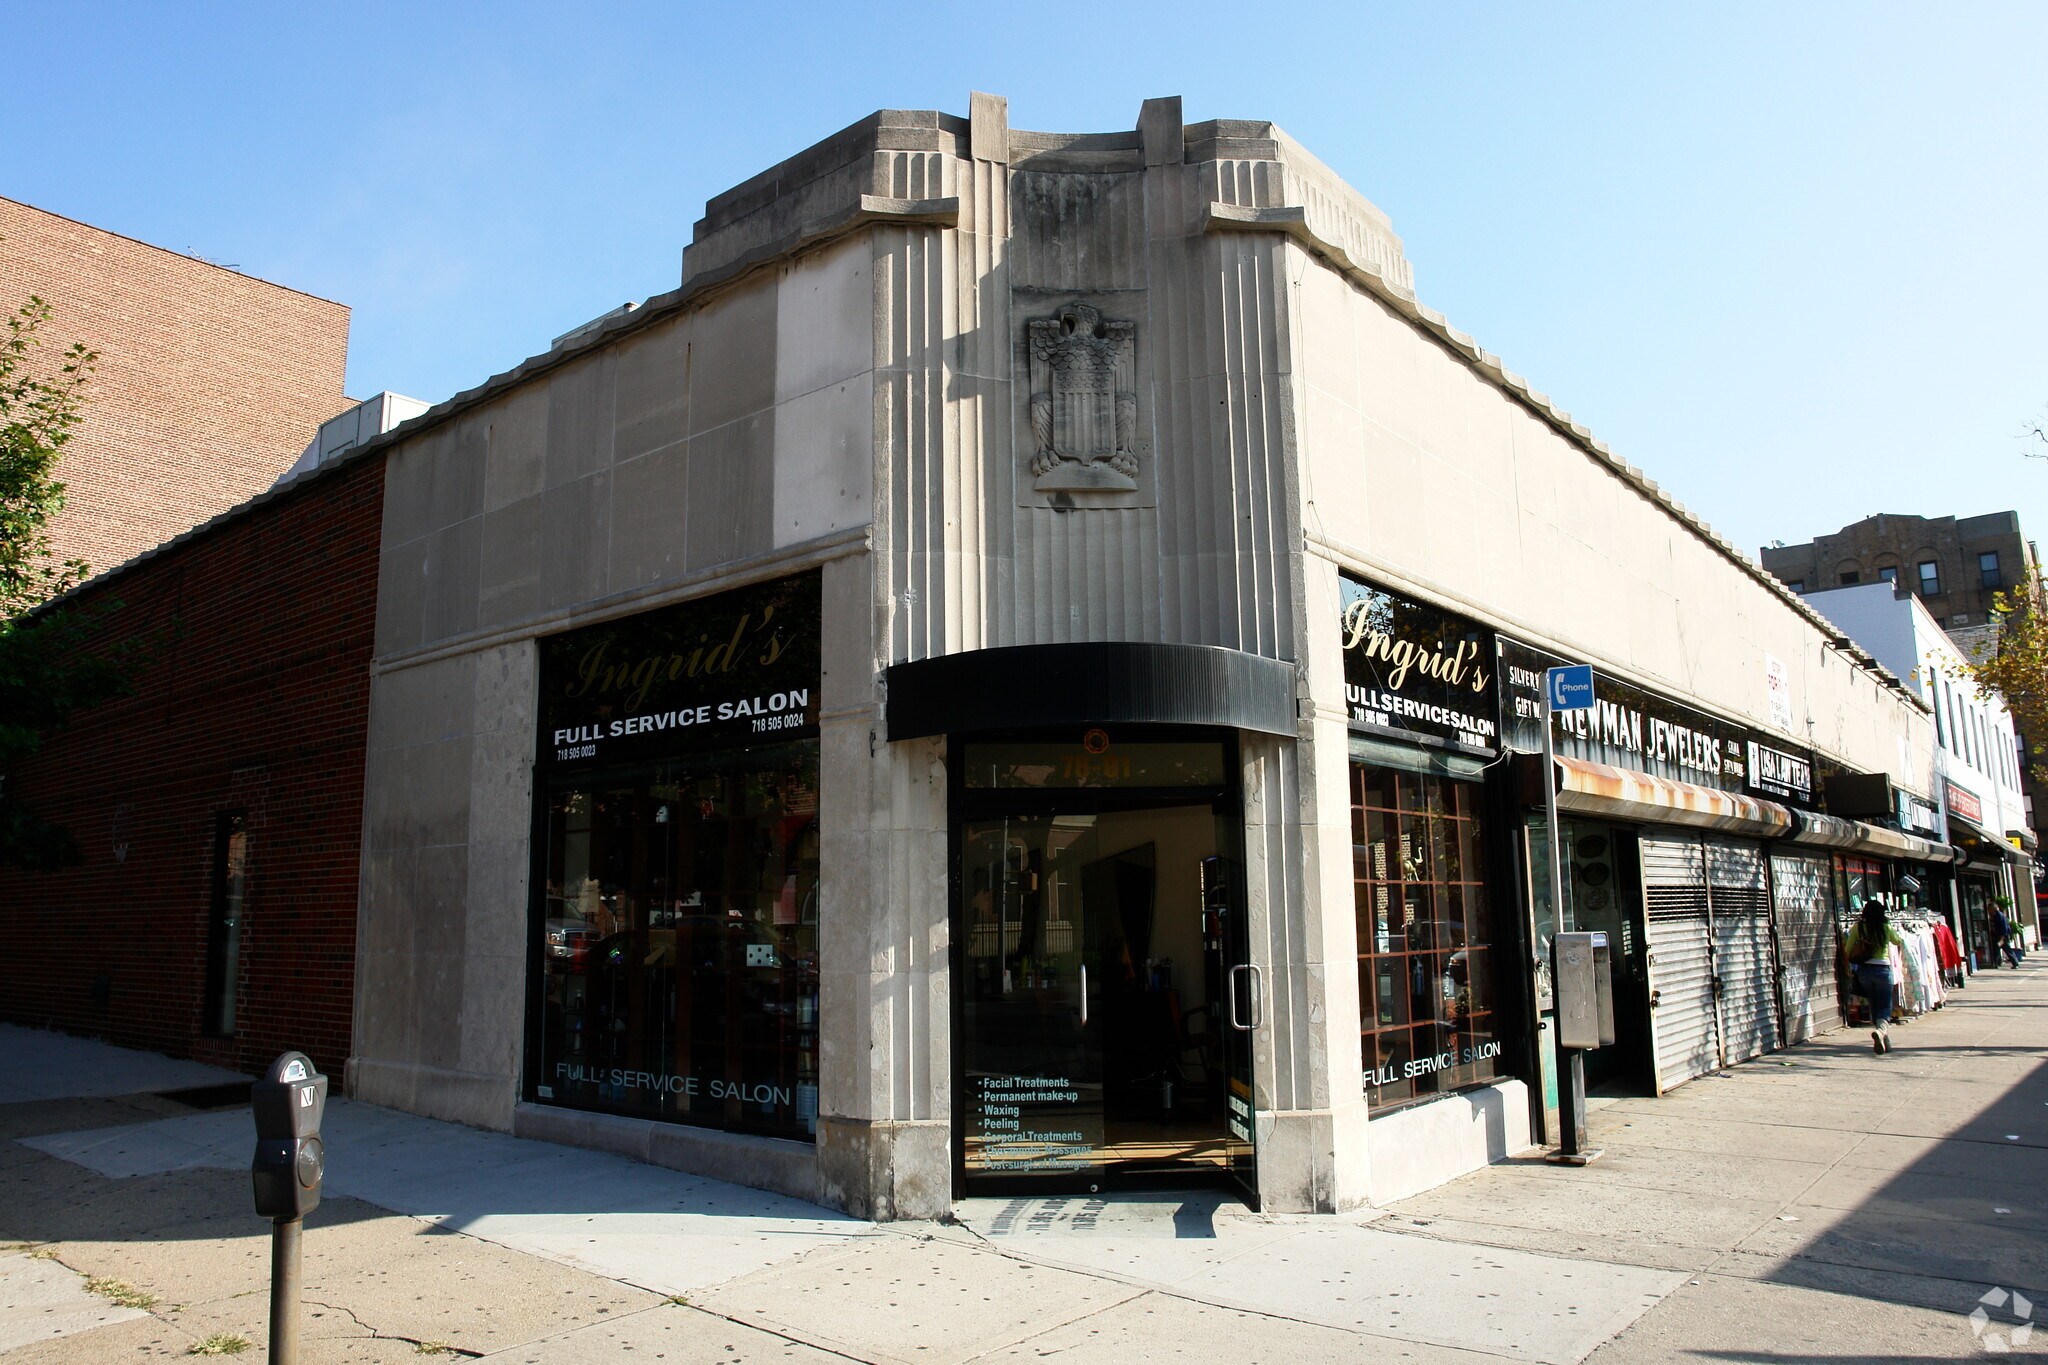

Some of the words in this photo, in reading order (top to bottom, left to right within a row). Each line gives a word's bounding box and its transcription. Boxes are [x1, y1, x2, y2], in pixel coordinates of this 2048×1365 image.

[1342, 599, 1489, 692] Ingrid's
[565, 606, 796, 713] Ingrid's
[1562, 684, 1589, 692] Phone
[1344, 683, 1381, 709] ULL
[1382, 692, 1451, 727] SERVICE
[1450, 711, 1495, 737] SALON
[1515, 696, 1532, 716] GIFT
[554, 723, 604, 746] FULL
[609, 705, 711, 738] SERVICE
[717, 688, 808, 722] SALON
[752, 718, 766, 734] 718
[767, 716, 782, 731] 505
[783, 712, 804, 729] 0024
[1561, 698, 1643, 753] NEWMAN
[1647, 716, 1721, 775] JEWELERS
[557, 749, 568, 761] 718
[569, 747, 580, 760] 505
[581, 744, 596, 758] 0023
[1760, 749, 1776, 779] USA
[1776, 754, 1792, 784] LAW
[1792, 760, 1811, 790] TEAM
[1363, 1065, 1399, 1088] FULL
[1404, 1050, 1459, 1079] SERVICE
[1463, 1041, 1501, 1063] SALON
[556, 1063, 600, 1083] FULL
[610, 1068, 699, 1096] SERVICE
[710, 1080, 790, 1106] SALON
[984, 1077, 1013, 1088] Facial
[1015, 1077, 1069, 1088] Treatments
[984, 1091, 1036, 1102] Permanent
[1038, 1090, 1078, 1103] make-up
[984, 1105, 1020, 1118] Waxing
[984, 1118, 1020, 1131] Peeling
[985, 1131, 1025, 1144] Corporal
[1028, 1131, 1083, 1142] Treatments
[1046, 1144, 1093, 1157] Massages
